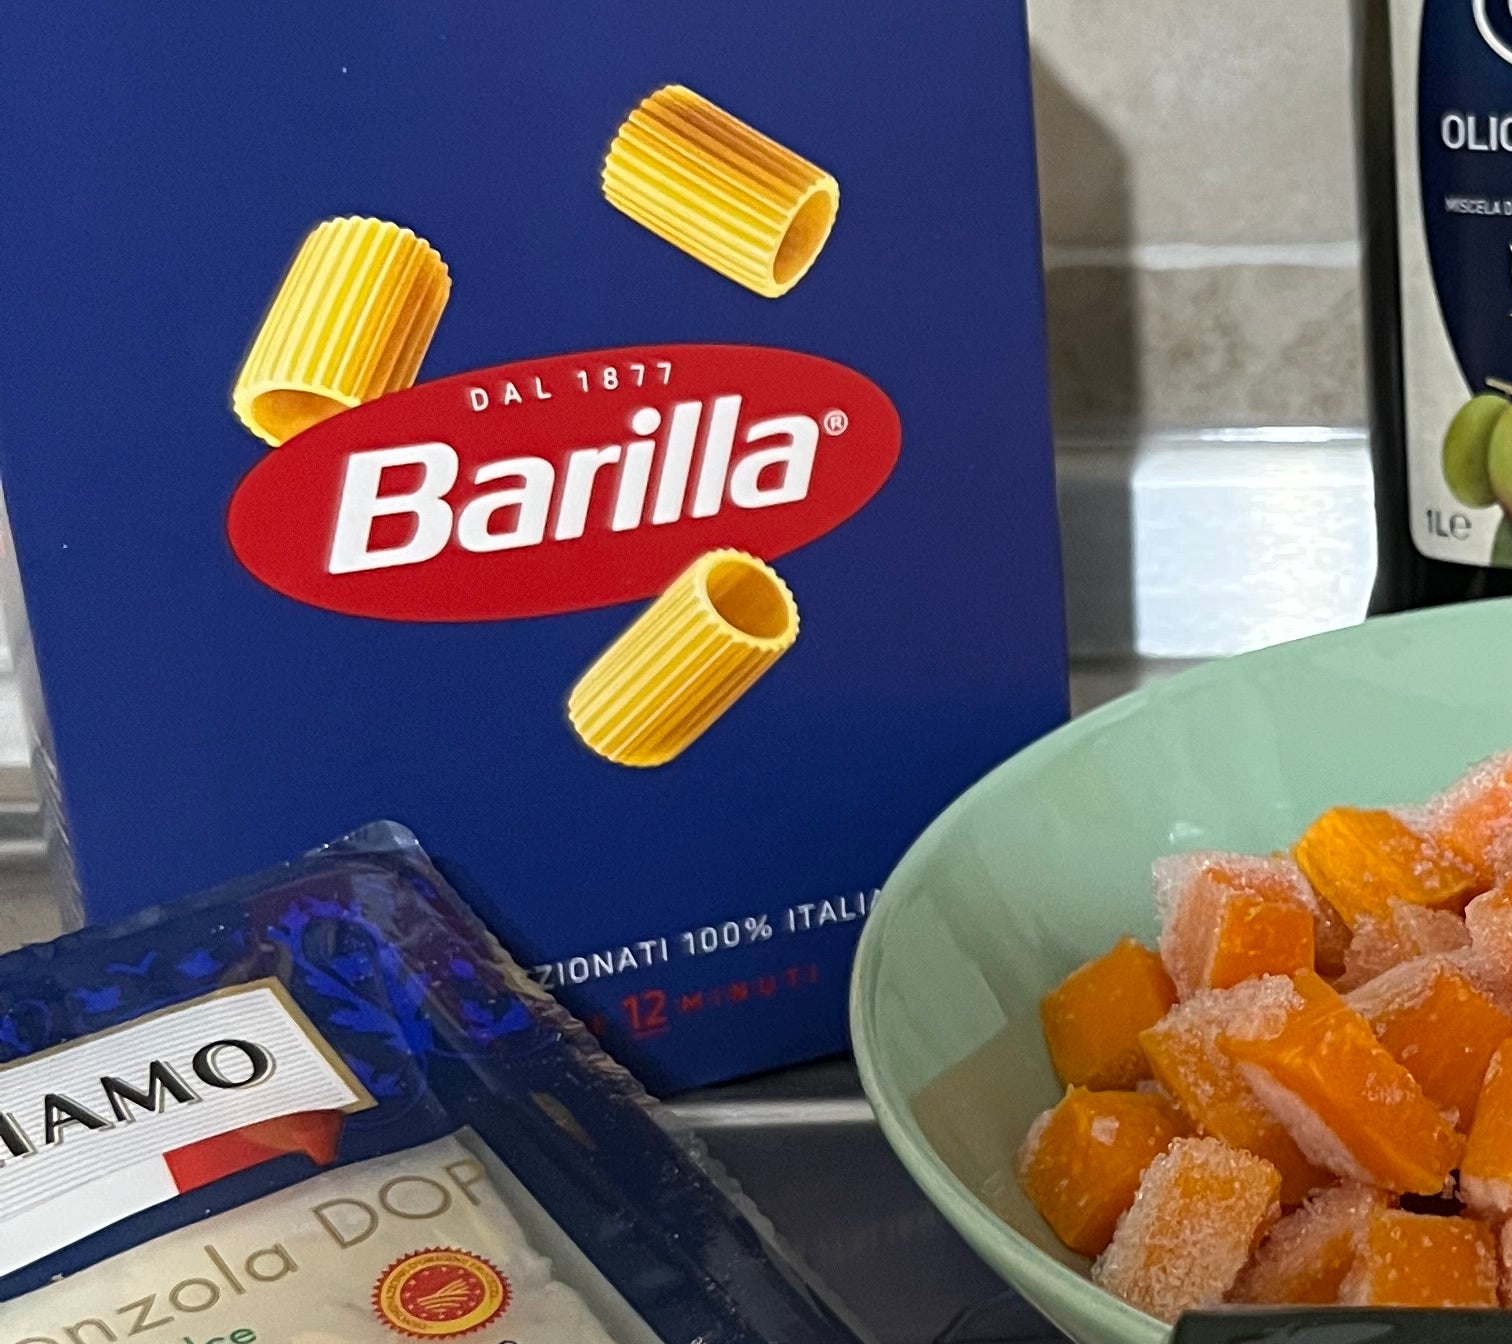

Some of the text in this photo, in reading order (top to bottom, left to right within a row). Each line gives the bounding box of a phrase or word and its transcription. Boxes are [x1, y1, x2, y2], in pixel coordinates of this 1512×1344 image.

[1445, 196, 1500, 215] MISCELA
[470, 361, 673, 412] DAL 1877
[530, 936, 669, 991] ZIONATI
[682, 914, 774, 957] 100%
[621, 989, 669, 1030] 12
[679, 964, 818, 1013] MINUTI
[311, 1157, 486, 1249] DOP
